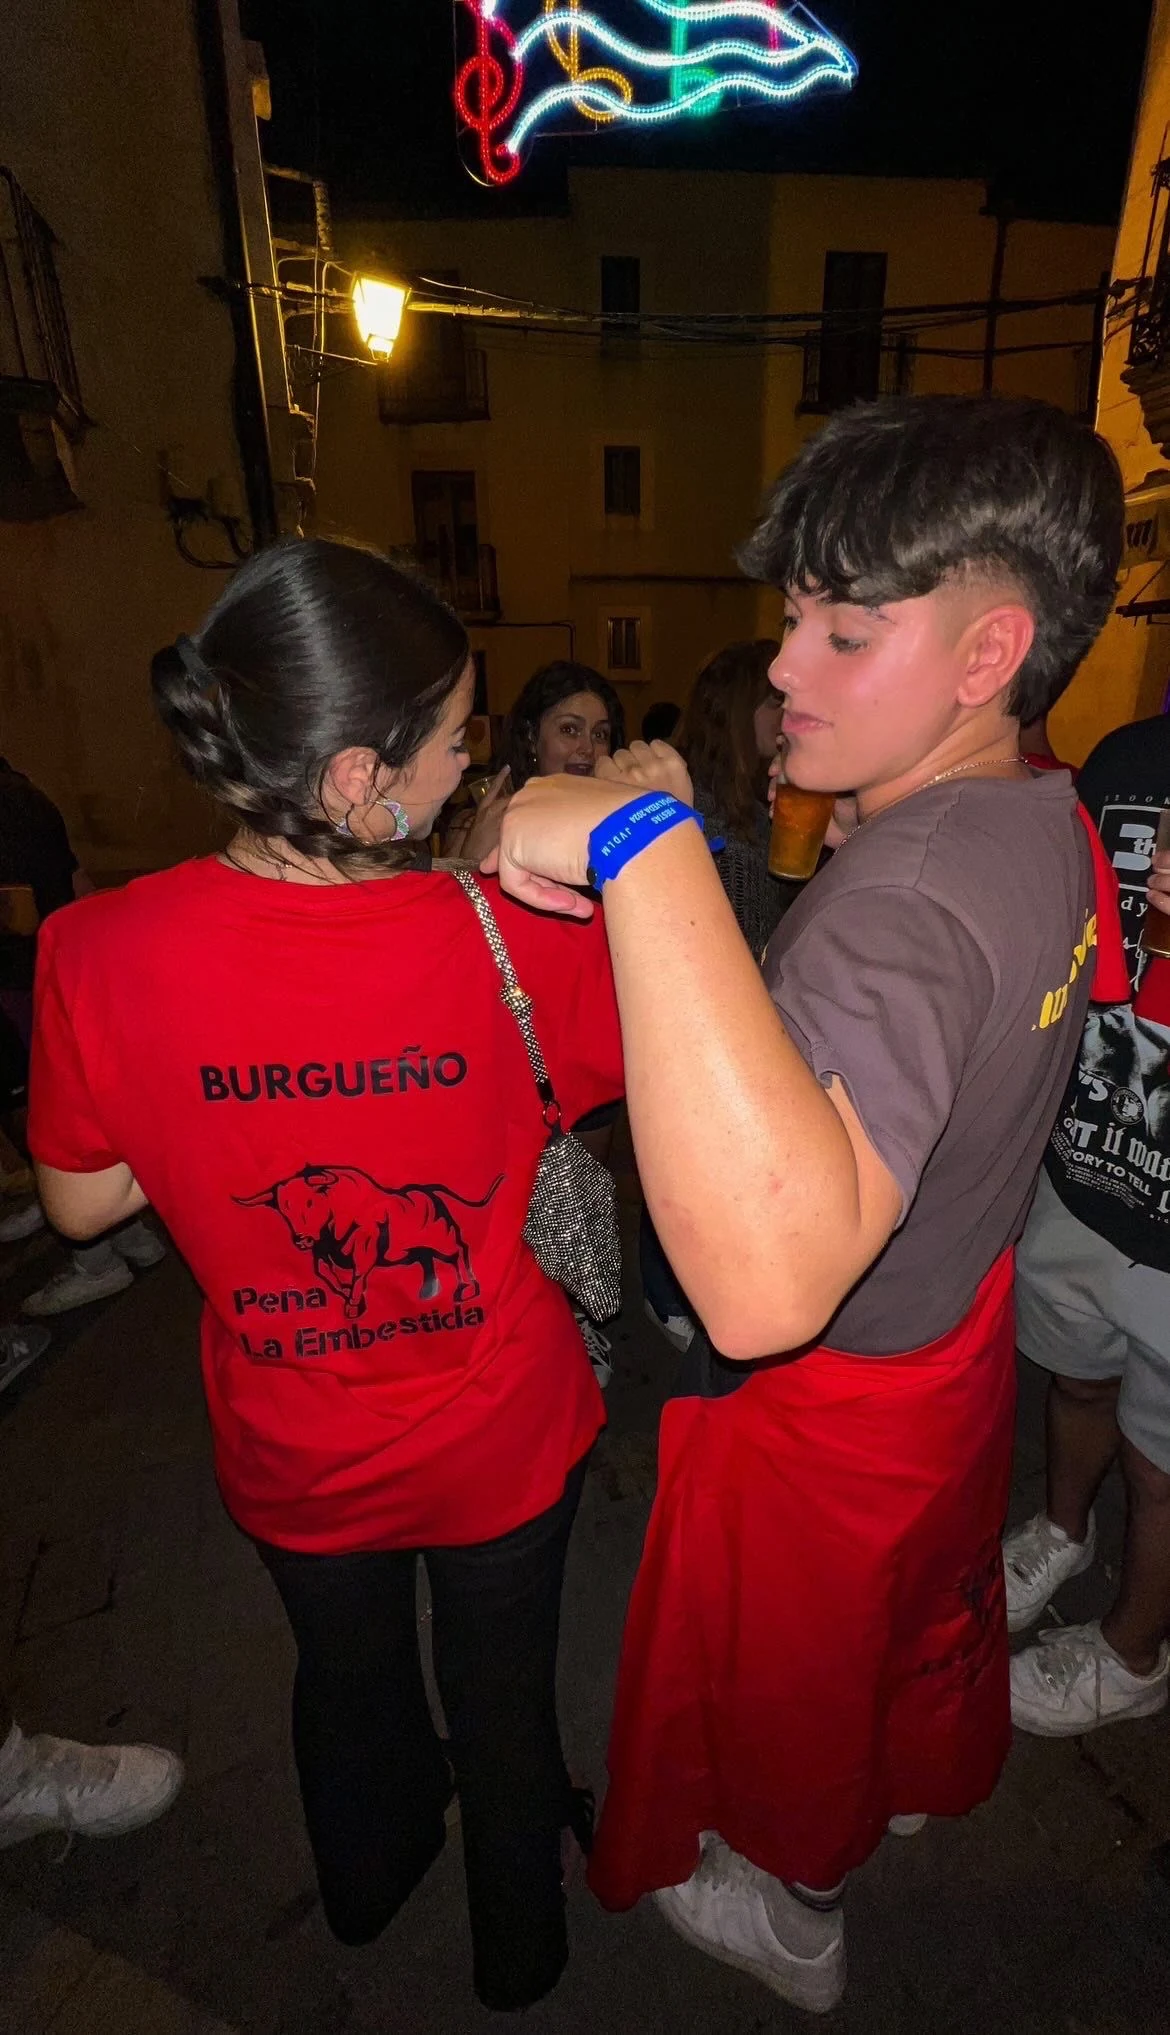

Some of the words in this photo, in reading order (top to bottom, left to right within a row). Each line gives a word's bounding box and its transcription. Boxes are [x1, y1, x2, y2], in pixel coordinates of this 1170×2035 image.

[629, 808, 647, 824] 2024
[651, 807, 677, 825] FIESTAS
[200, 1045, 469, 1101] BURGUEÑO
[1106, 1162, 1126, 1177] TO
[1127, 1171, 1152, 1196] TELL
[240, 1332, 283, 1359] La
[295, 1304, 486, 1358] Embestida
